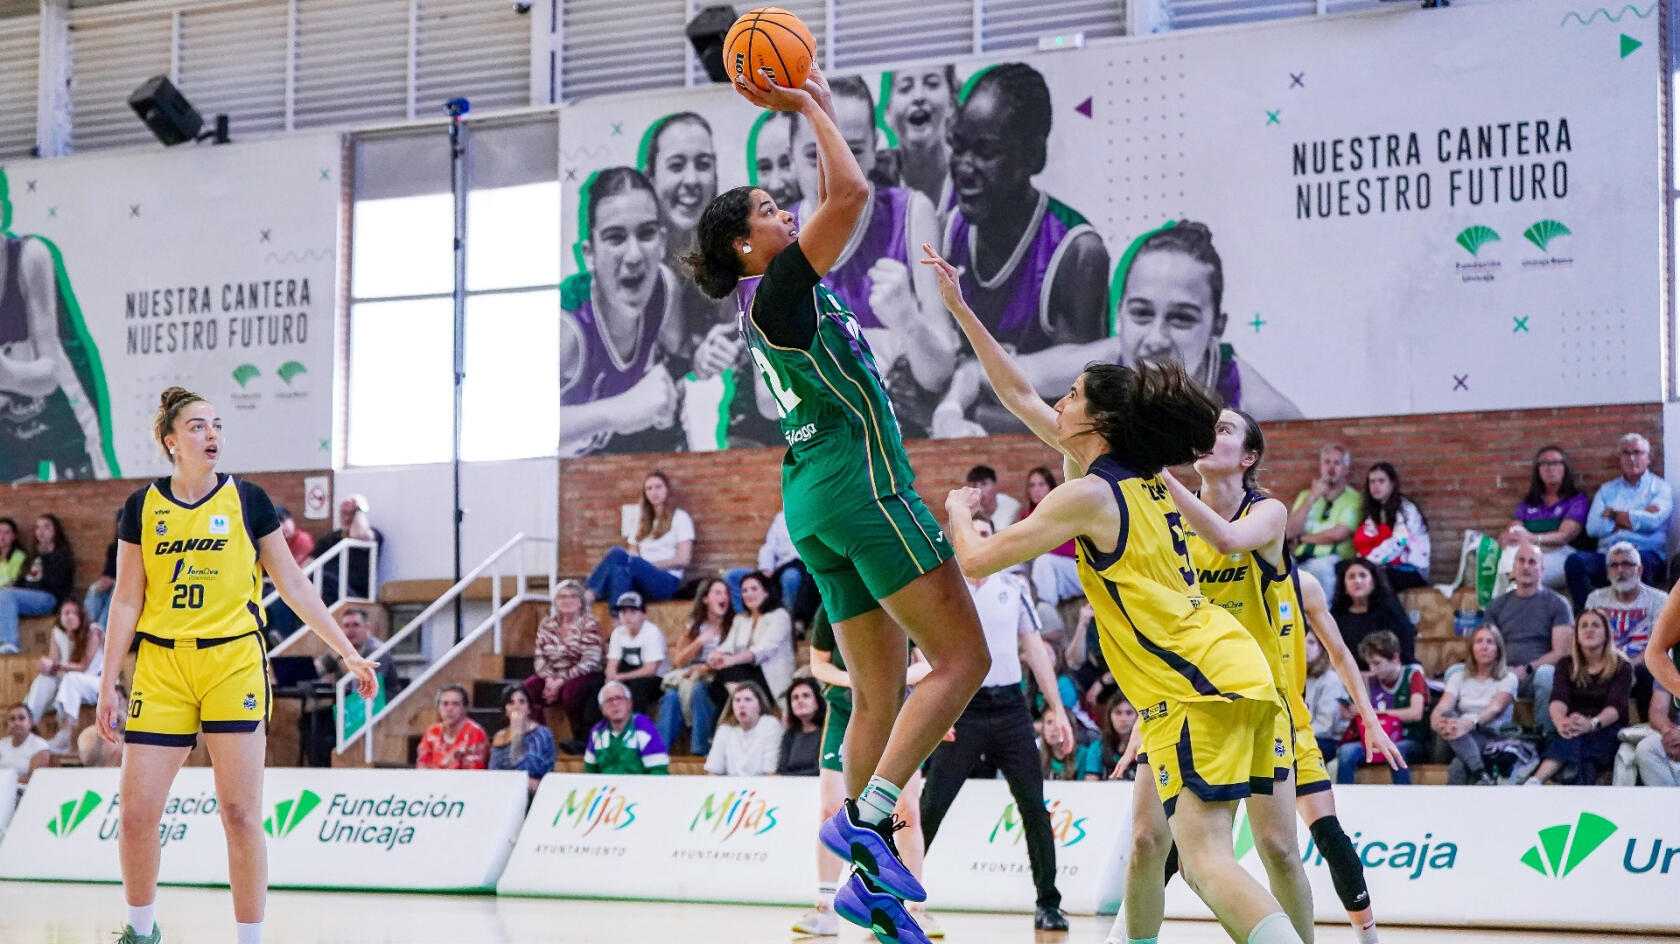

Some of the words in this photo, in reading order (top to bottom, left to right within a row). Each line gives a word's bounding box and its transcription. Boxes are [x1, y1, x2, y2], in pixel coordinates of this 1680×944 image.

[1293, 132, 1421, 176] NUESTRA
[1437, 118, 1572, 163] CANTERA
[1297, 172, 1431, 219] NUESTRO
[1450, 161, 1569, 206] FUTURO
[126, 286, 211, 319] NUESTRA
[222, 278, 311, 312] CANTERA
[127, 319, 217, 355] NUESTRO
[228, 313, 308, 347] FUTURO
[155, 538, 229, 555] CANOE
[1197, 565, 1249, 584] NOE
[172, 584, 205, 609] 20
[107, 791, 221, 815] Fació
[327, 794, 465, 819] Fundación
[552, 786, 638, 837] Mijas
[690, 790, 779, 843] Mijas
[98, 818, 188, 848] Uaja
[318, 820, 415, 851] Unicaja
[988, 798, 1088, 848] Mas
[535, 844, 626, 857] AYUNTAMIENTO
[672, 849, 769, 863] AYUNTAMIENTO
[1301, 831, 1458, 880] icaja
